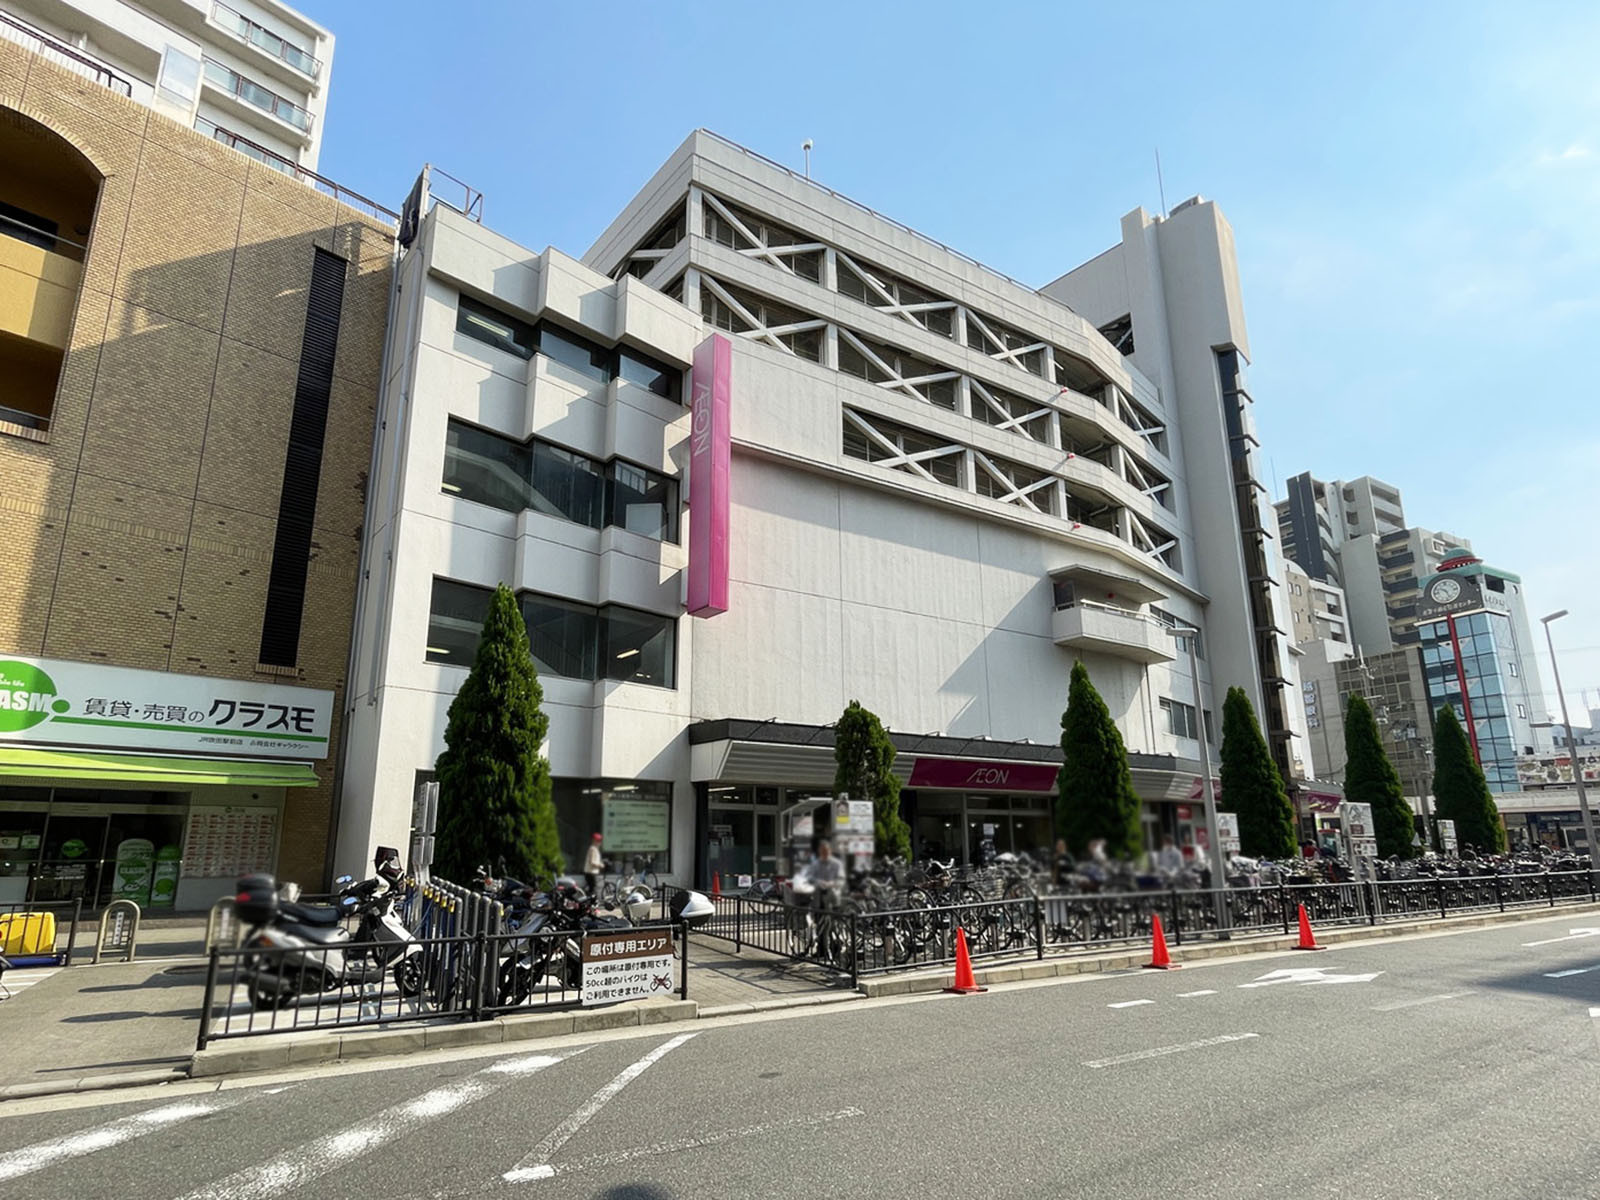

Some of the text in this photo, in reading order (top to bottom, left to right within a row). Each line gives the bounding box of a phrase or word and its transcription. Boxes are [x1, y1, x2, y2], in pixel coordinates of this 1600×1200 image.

[83, 698, 315, 733] 賃貸・売買のクラスモ
[590, 938, 667, 956] 原付専用エリア
